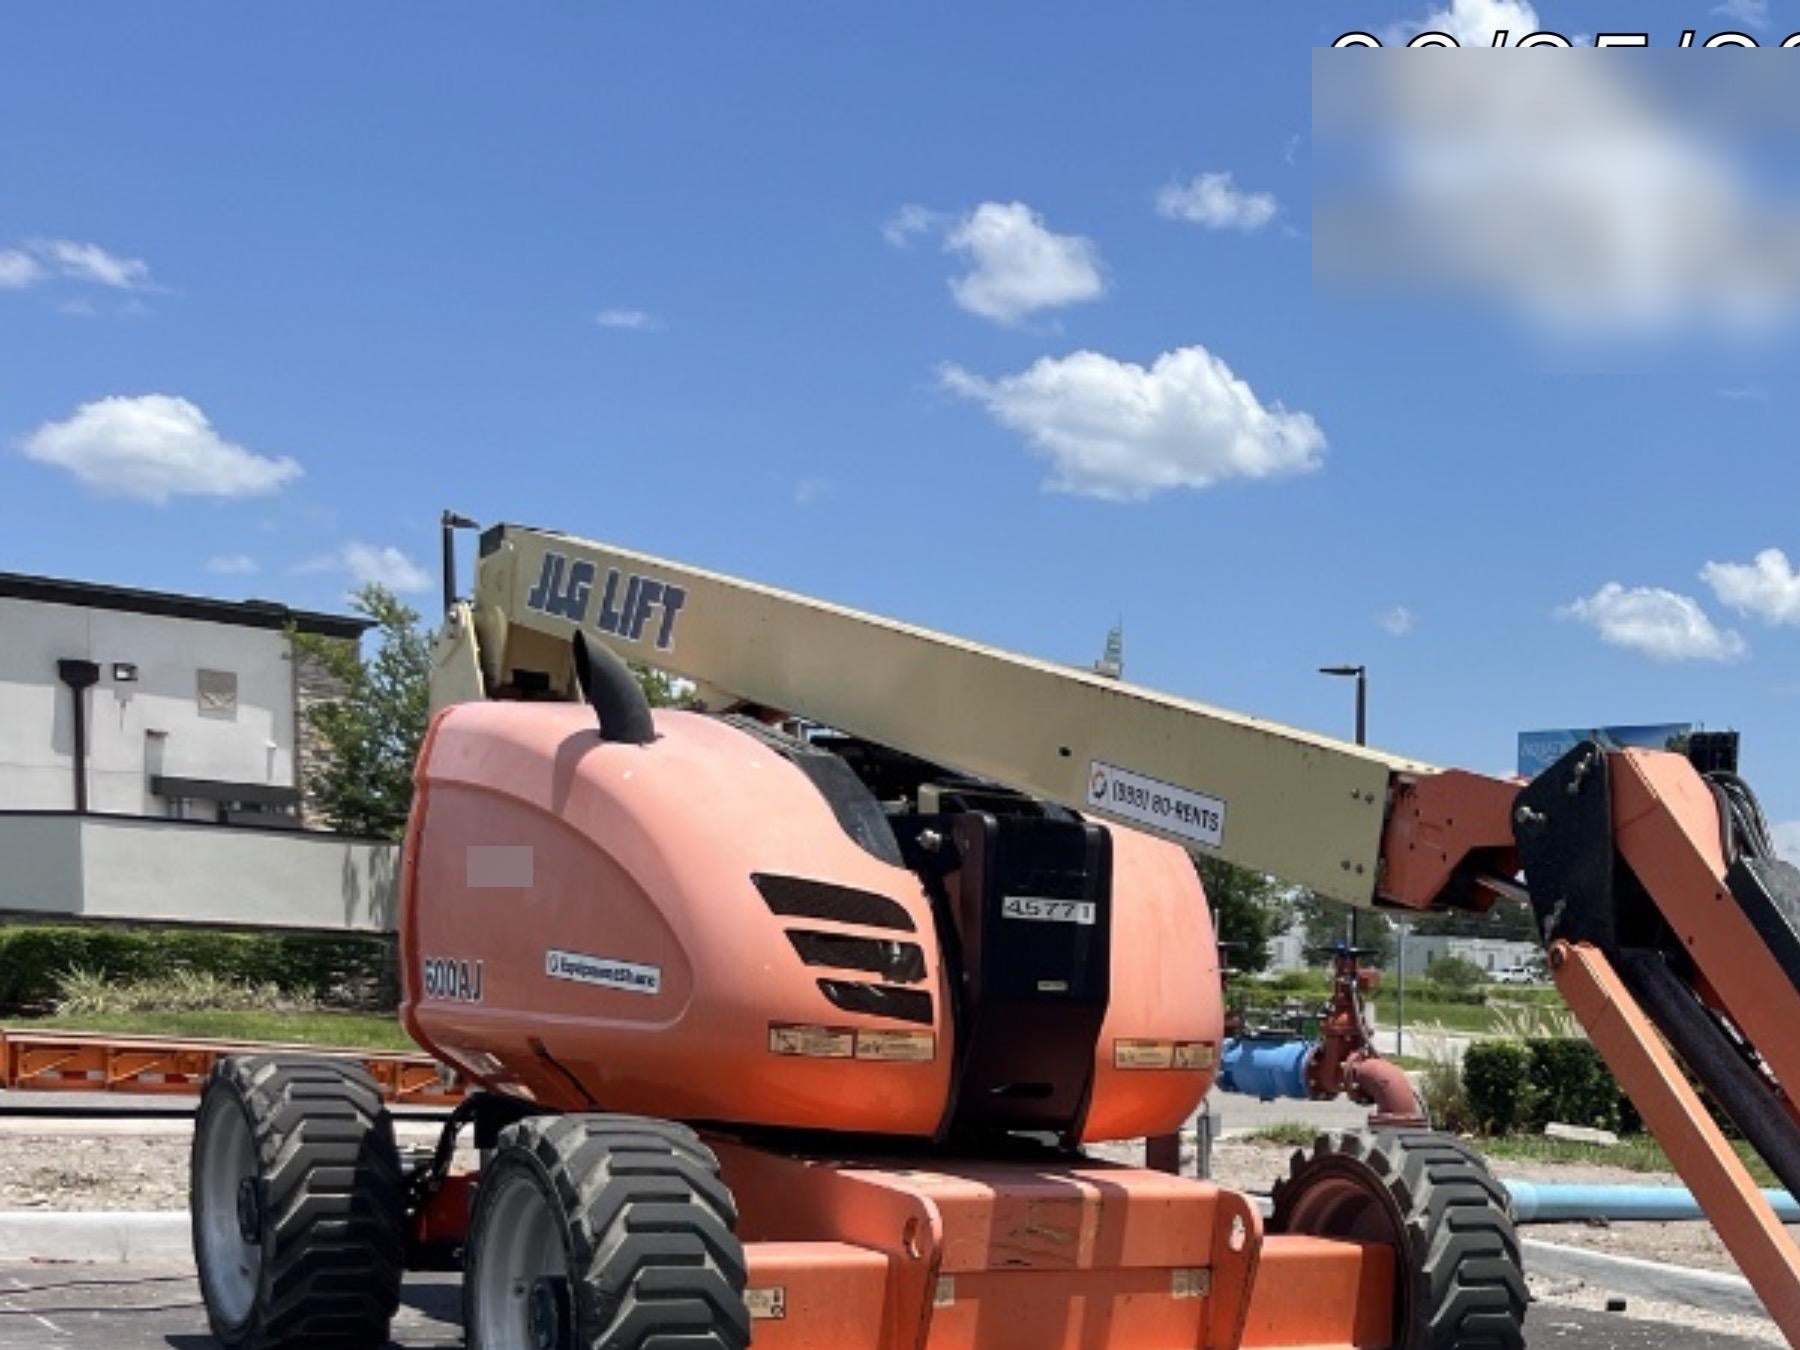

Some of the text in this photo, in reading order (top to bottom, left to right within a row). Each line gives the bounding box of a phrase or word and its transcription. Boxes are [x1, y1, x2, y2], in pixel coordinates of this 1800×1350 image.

[527, 552, 688, 652] JLG LIFT
[1007, 900, 1089, 919] 45771
